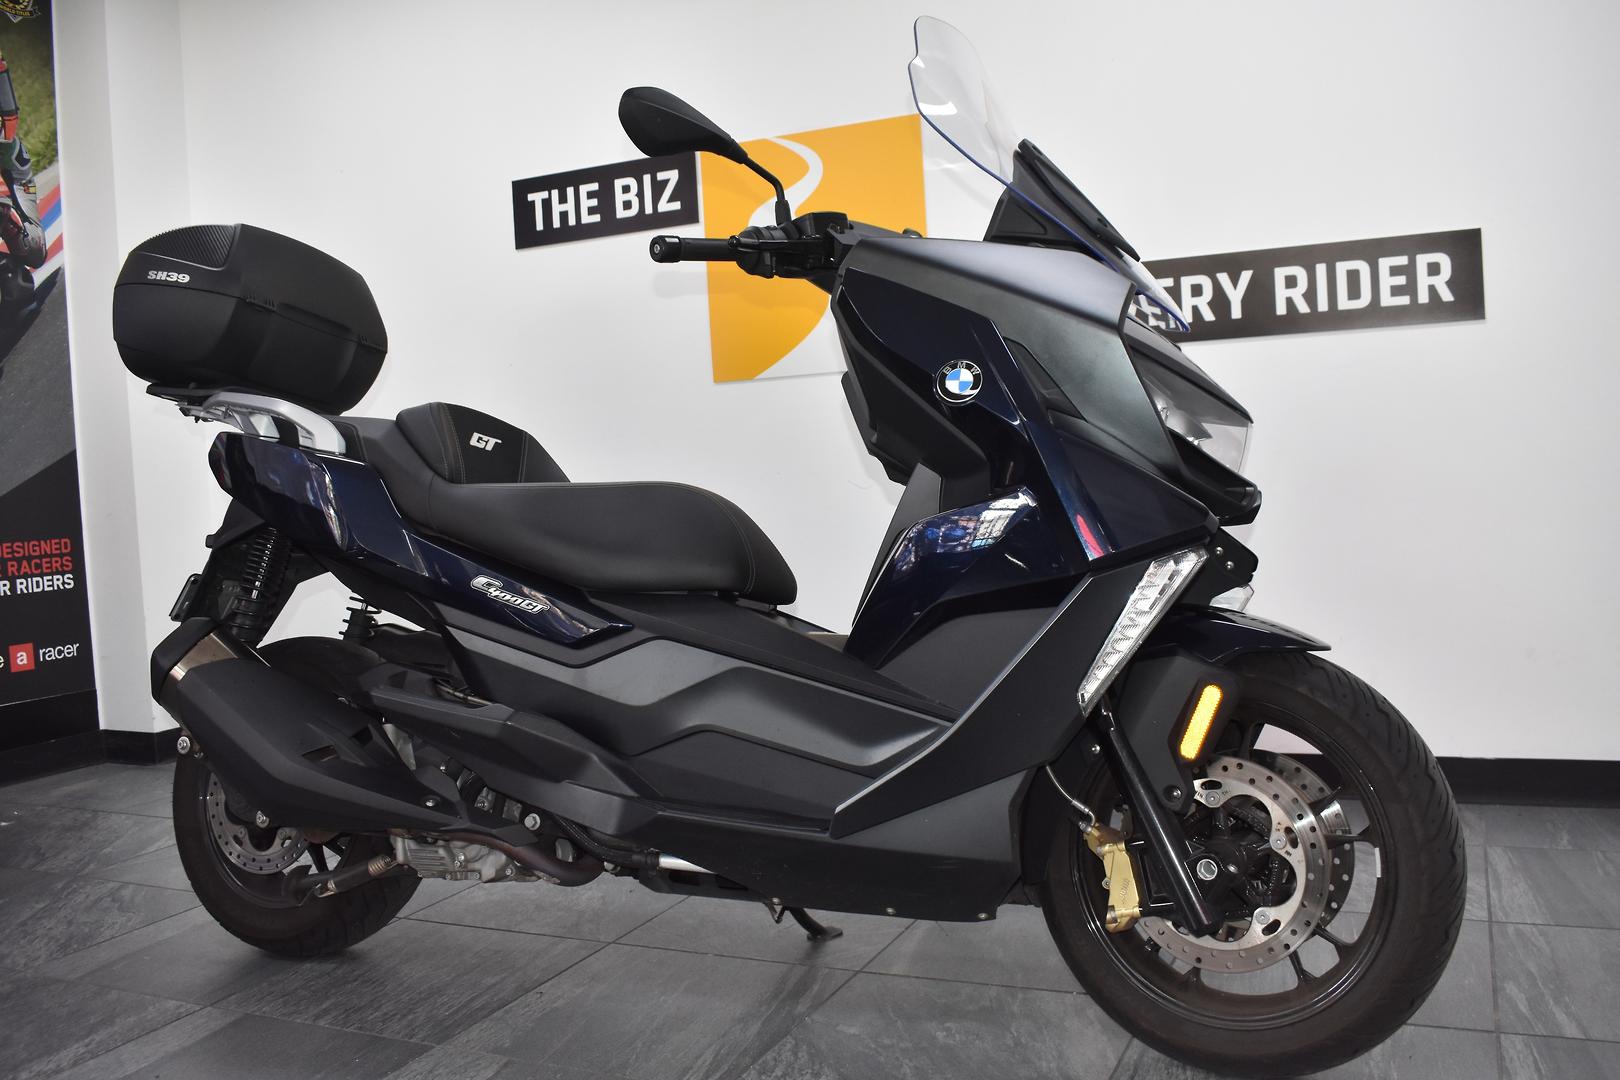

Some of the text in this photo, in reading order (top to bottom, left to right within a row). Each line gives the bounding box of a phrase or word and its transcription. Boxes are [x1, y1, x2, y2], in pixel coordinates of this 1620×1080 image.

[527, 169, 681, 231] THE BIZ
[147, 270, 190, 283] SH39
[1273, 252, 1455, 315] RIDER
[942, 361, 980, 375] BMW
[470, 432, 502, 451] GT
[0, 538, 71, 558] ESIGNED
[7, 556, 73, 576] RACERS
[16, 574, 74, 594] RIDERS
[17, 651, 28, 665] a
[39, 643, 80, 661] racer
